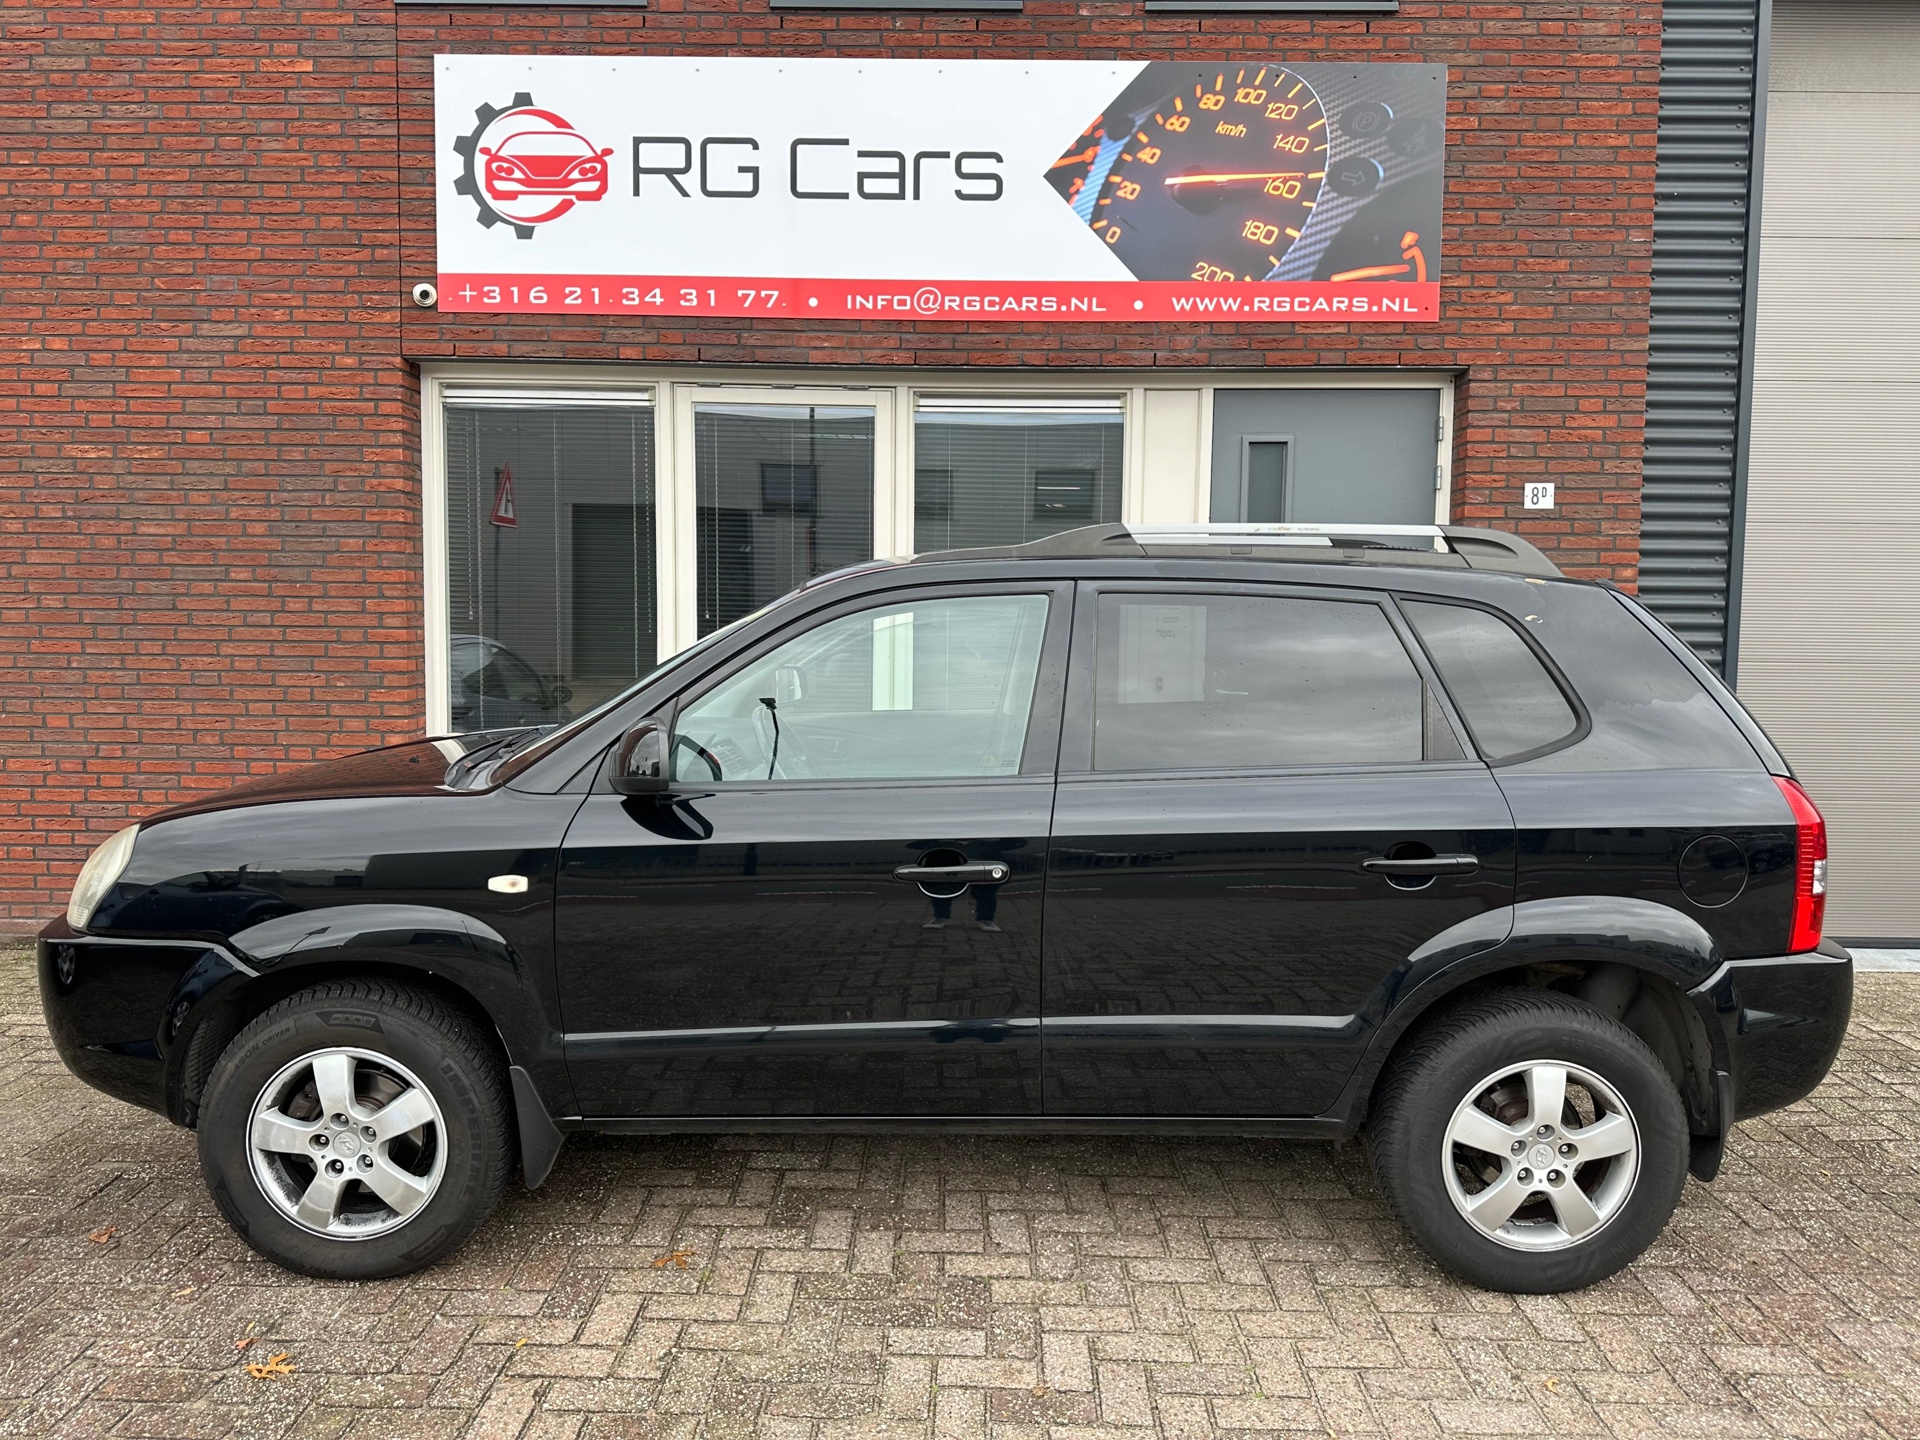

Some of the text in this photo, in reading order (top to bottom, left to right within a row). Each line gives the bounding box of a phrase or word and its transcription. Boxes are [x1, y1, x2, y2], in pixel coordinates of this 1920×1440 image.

[1199, 93, 1225, 111] 80
[1234, 87, 1267, 105] 100
[1265, 102, 1298, 120] 120
[1165, 114, 1191, 132] 60
[1215, 121, 1247, 138] km/h
[1273, 134, 1309, 154] 140
[1136, 146, 1162, 164] 40
[632, 136, 1004, 202] RG Cars
[1115, 181, 1141, 200] 20
[1263, 177, 1301, 199] 160
[1105, 226, 1121, 244] 0
[1242, 219, 1279, 245] 180
[458, 283, 548, 304] +316
[680, 288, 716, 307] 31
[846, 286, 1107, 315] INFO@RGCARS.NL
[1171, 297, 1419, 313] WWW.RGCARS.NL
[262, 1026, 291, 1046] DRIVER
